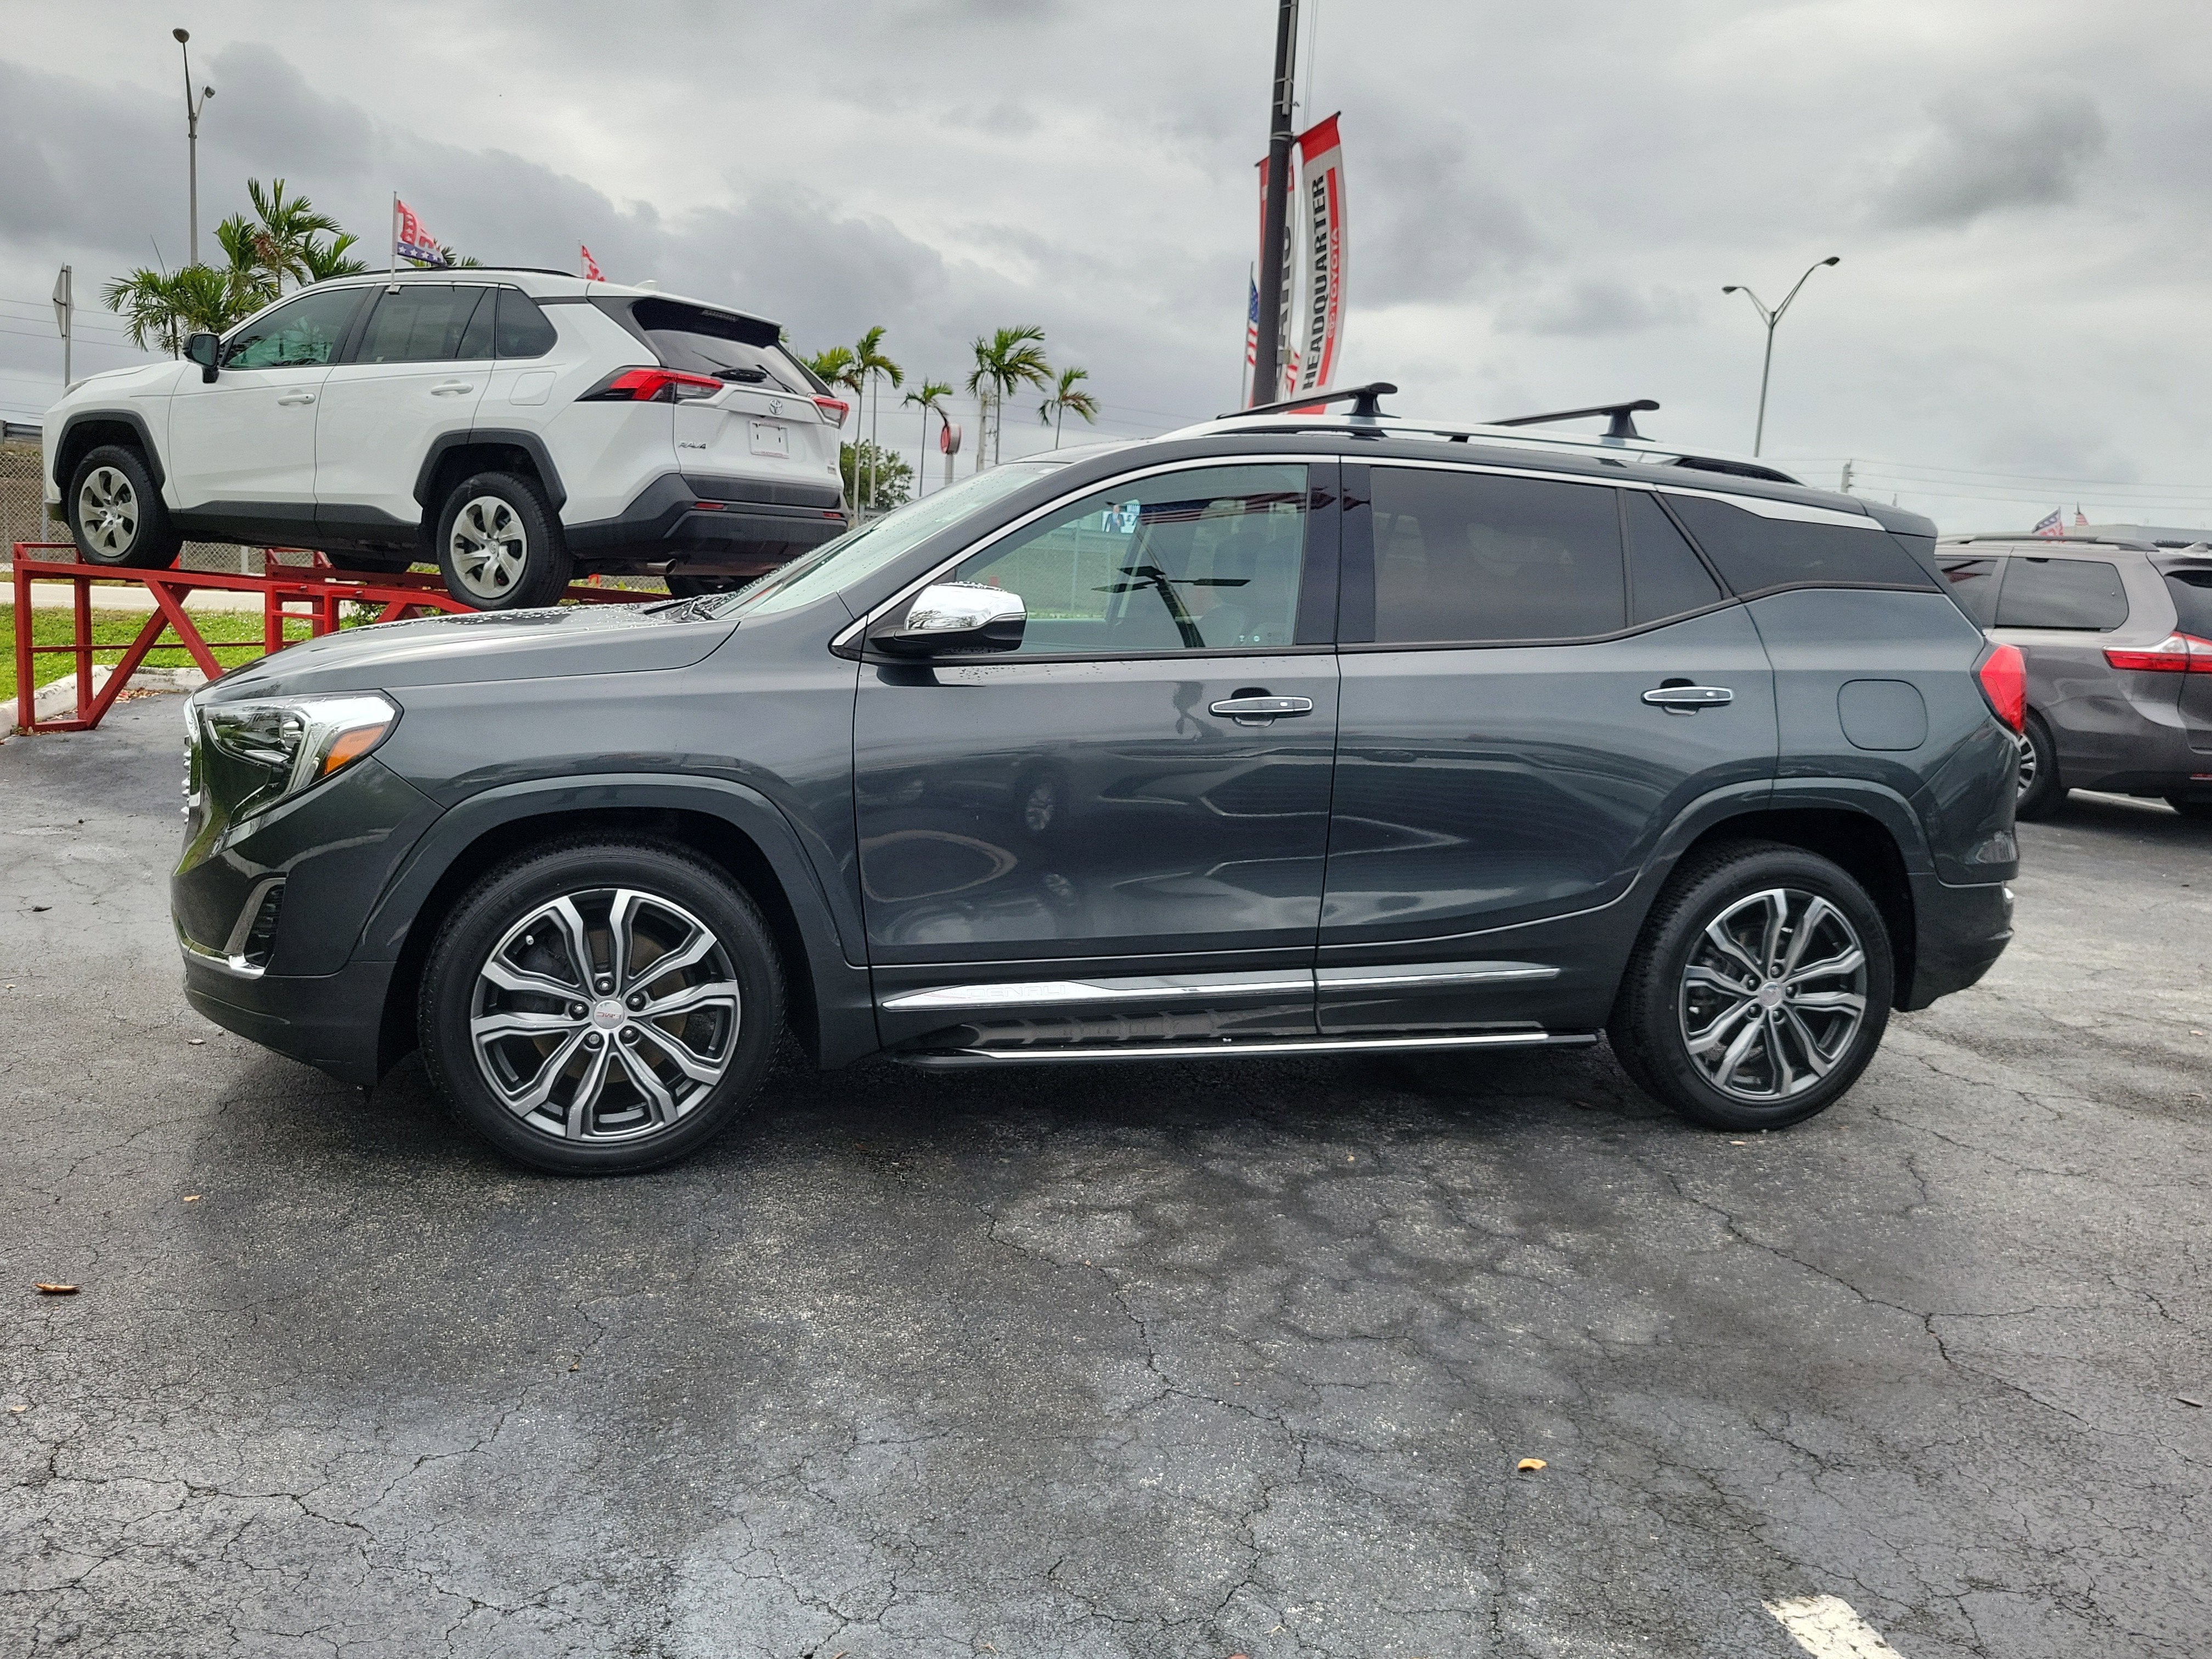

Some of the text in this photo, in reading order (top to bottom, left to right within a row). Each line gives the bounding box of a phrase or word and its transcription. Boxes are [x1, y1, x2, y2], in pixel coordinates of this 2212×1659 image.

[1302, 175, 1328, 390] HEADQUARTER
[1329, 227, 1339, 308] TOYOTA
[967, 985, 1066, 998] DENALI
